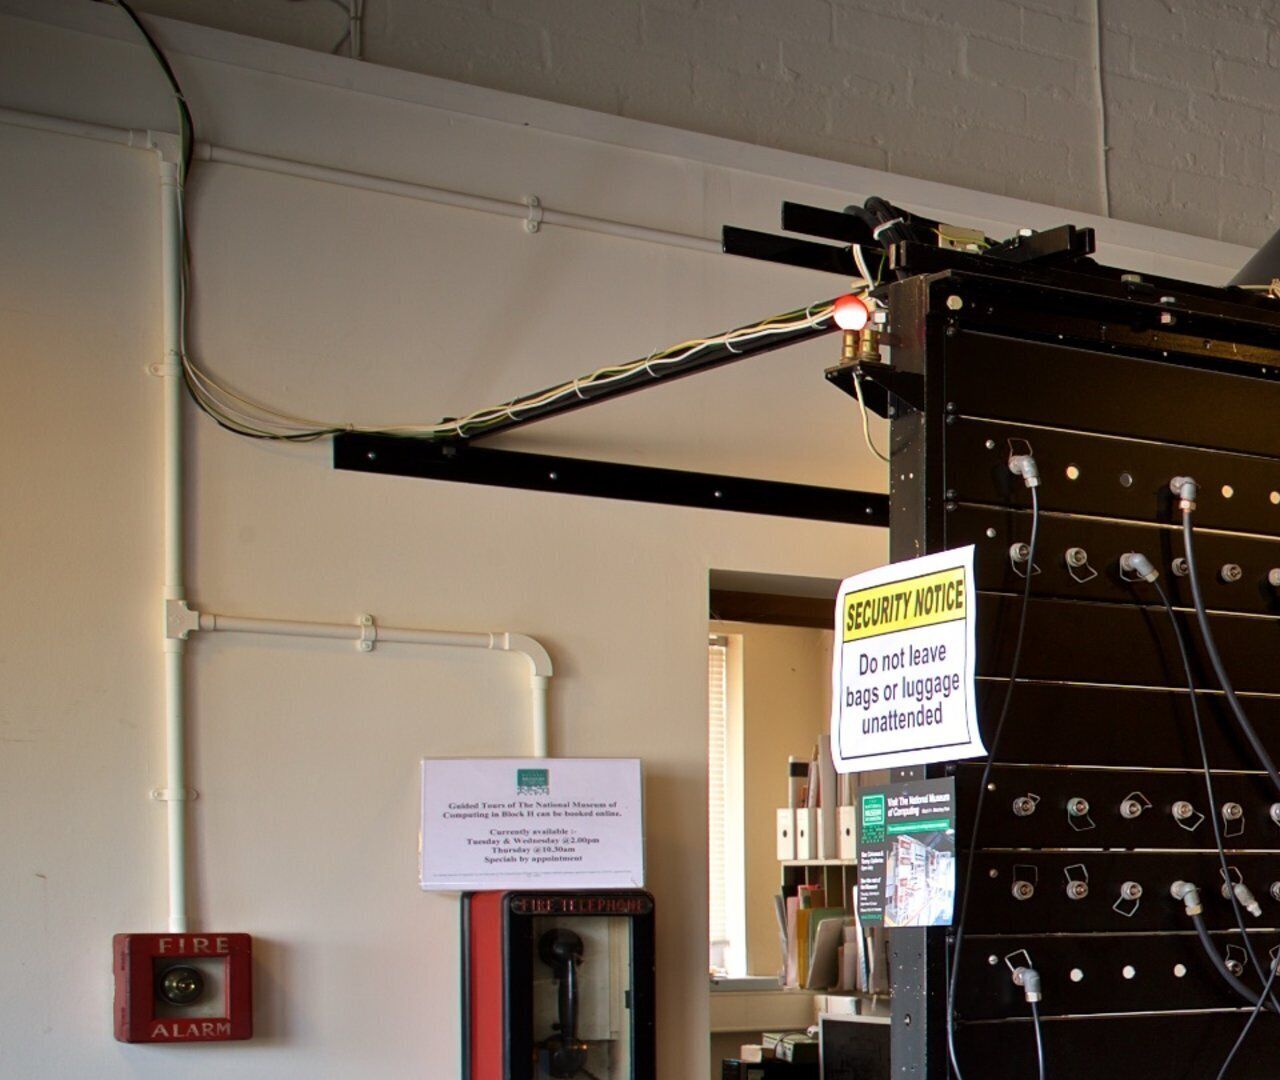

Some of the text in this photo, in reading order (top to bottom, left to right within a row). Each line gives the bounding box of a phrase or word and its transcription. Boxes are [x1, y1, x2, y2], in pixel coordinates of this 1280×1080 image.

[846, 580, 963, 631] SECURITY NOTICE
[859, 644, 947, 675] Do not leave
[846, 673, 960, 710] bags or luggage
[862, 702, 943, 734] unattended
[159, 937, 230, 954] FIRE
[151, 1021, 231, 1039] ALARM
